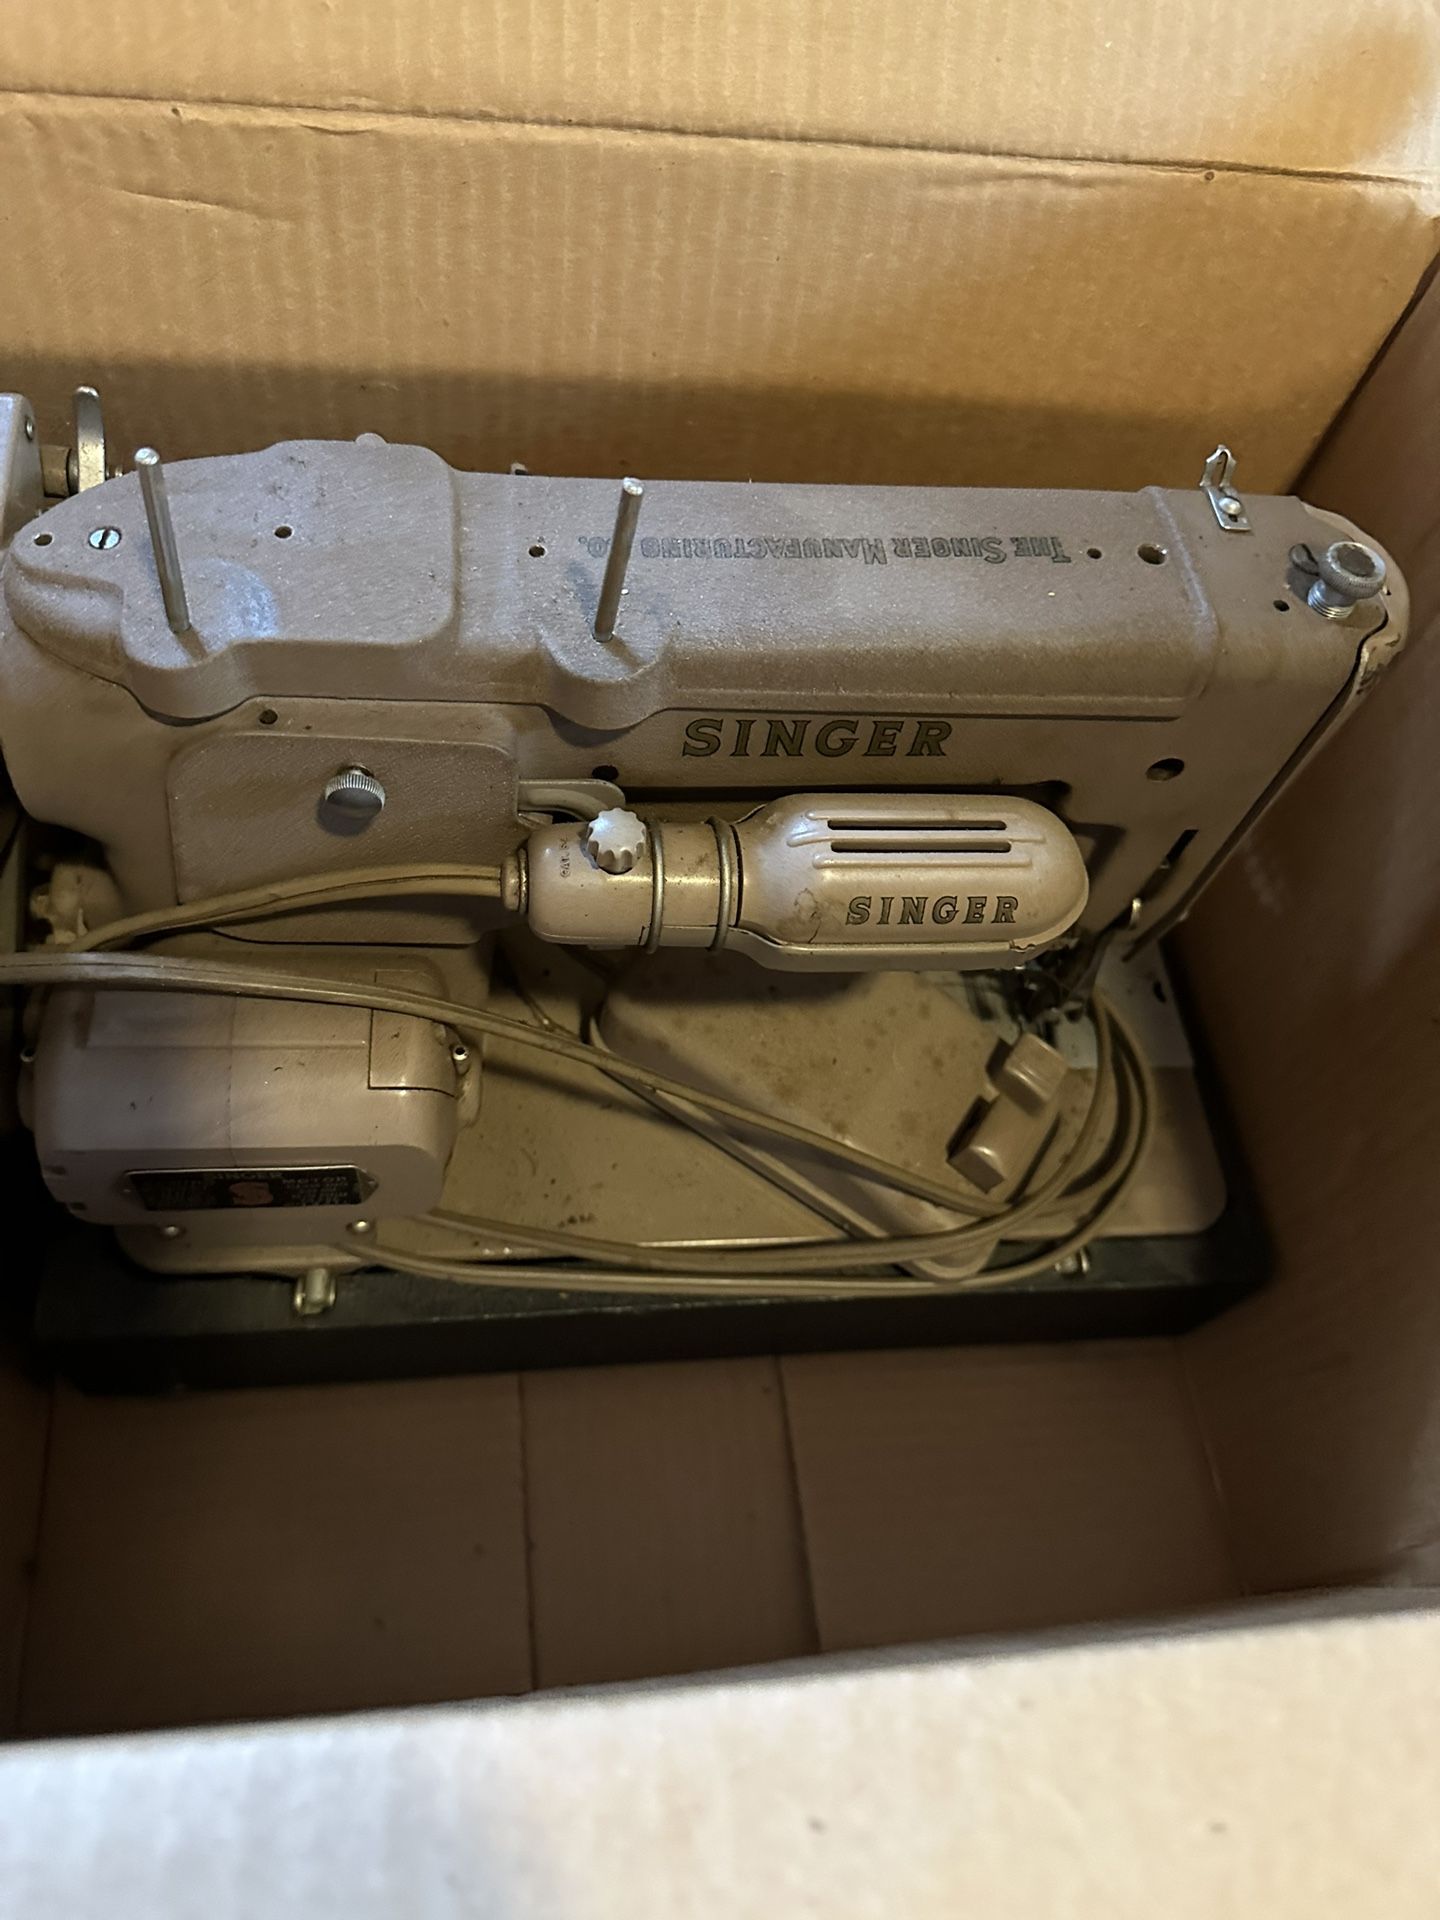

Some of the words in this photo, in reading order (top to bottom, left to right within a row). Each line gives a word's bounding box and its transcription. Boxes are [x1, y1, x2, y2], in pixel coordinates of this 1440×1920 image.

[640, 536, 888, 565] MANUFACTURING
[892, 536, 1007, 564] SINGER
[1011, 536, 1072, 563] THE
[682, 718, 953, 758] SINGER
[845, 895, 1019, 925] SINGER
